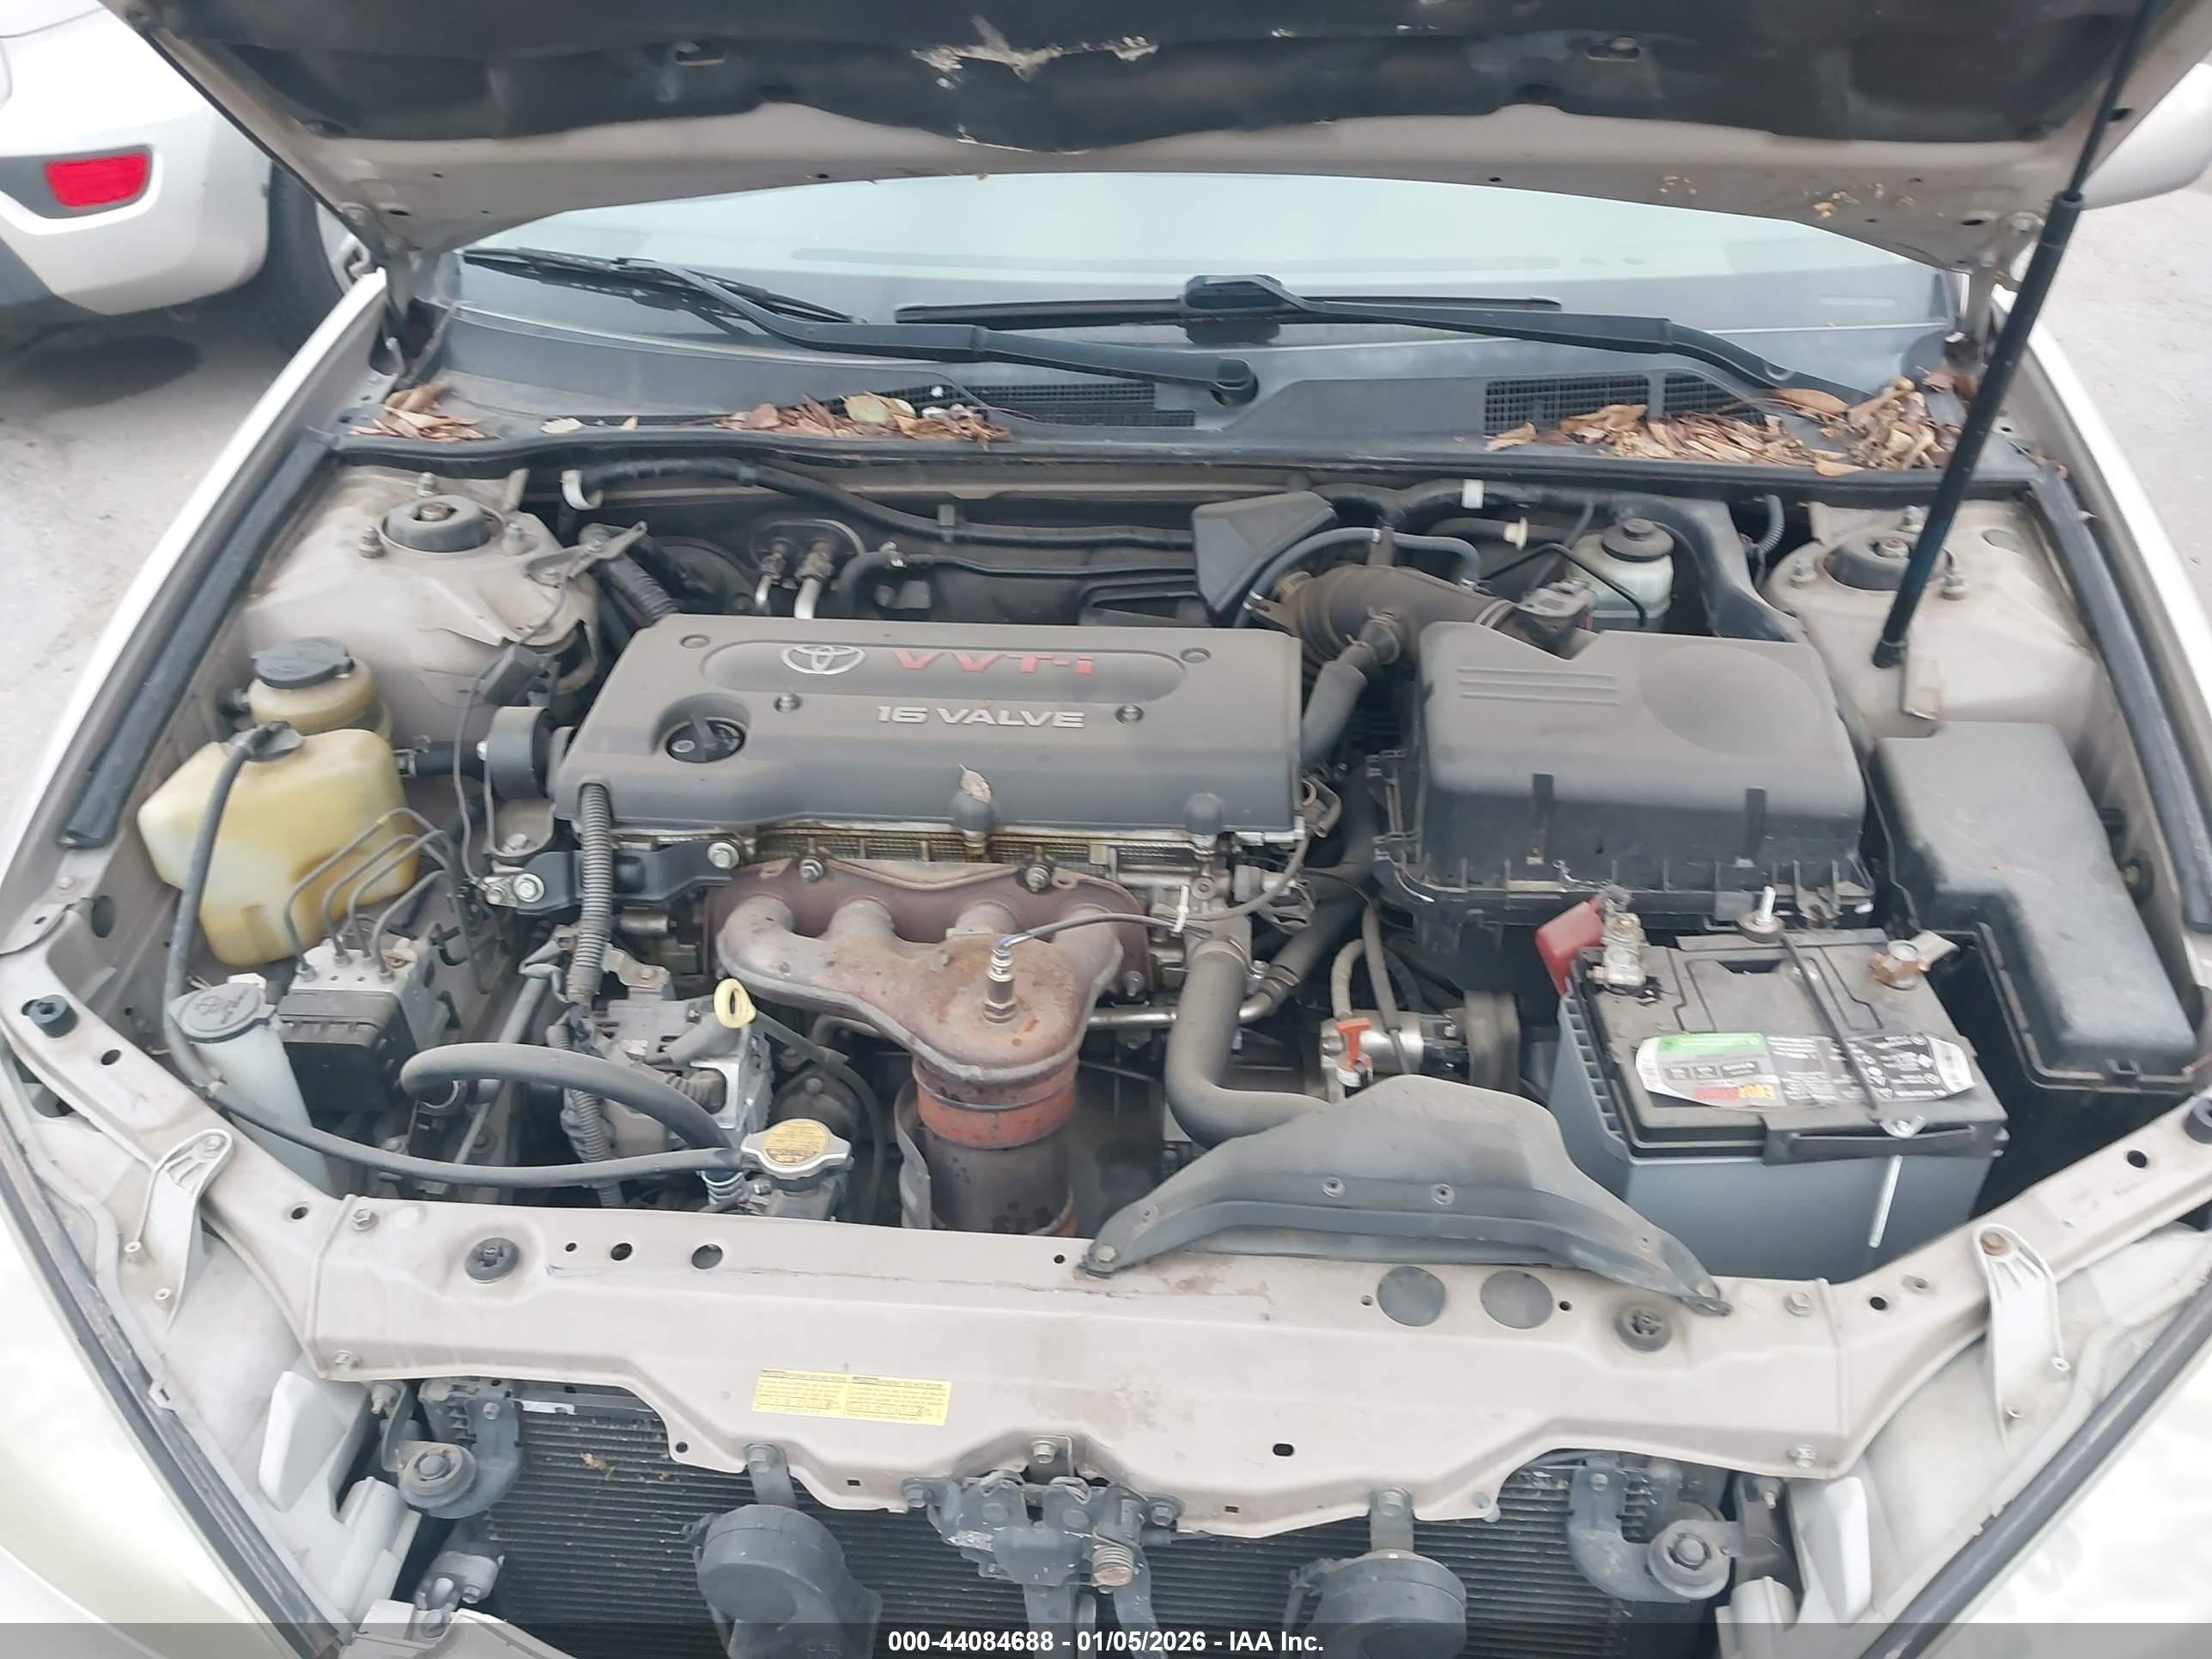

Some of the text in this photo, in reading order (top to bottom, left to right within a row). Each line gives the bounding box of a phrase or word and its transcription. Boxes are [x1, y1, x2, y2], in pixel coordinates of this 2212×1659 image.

[893, 650, 1095, 677] VVT-i
[877, 705, 1086, 729] 16 VALVE
